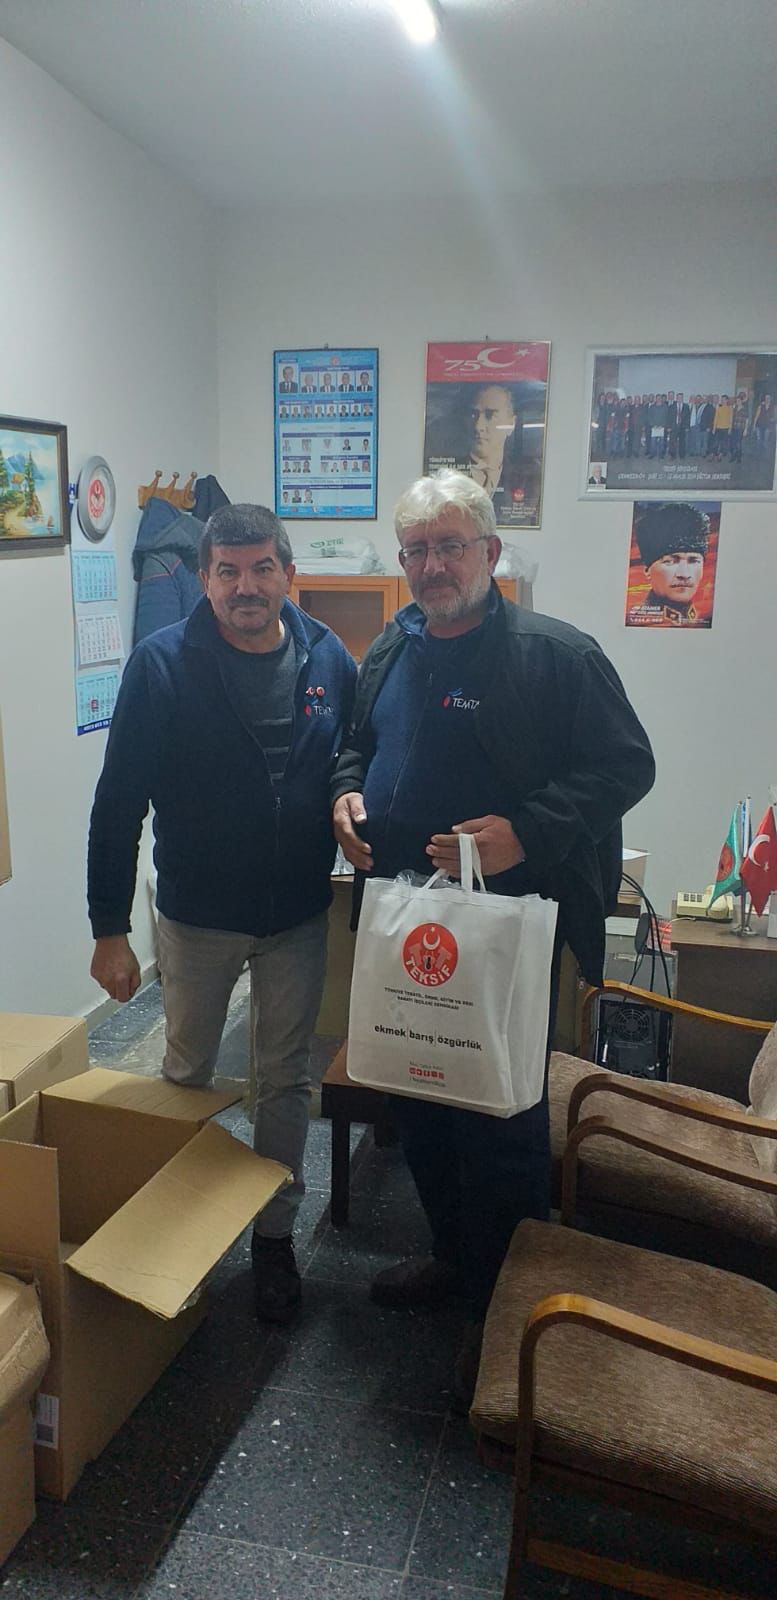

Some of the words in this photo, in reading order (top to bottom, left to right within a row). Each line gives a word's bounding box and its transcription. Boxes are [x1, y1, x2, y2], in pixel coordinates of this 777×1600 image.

[444, 359, 481, 372] 75
[405, 955, 451, 985] TEKSİF
[374, 1024, 406, 1038] ekmek
[409, 1029, 434, 1044] barış
[437, 1034, 482, 1051] özgürlük
